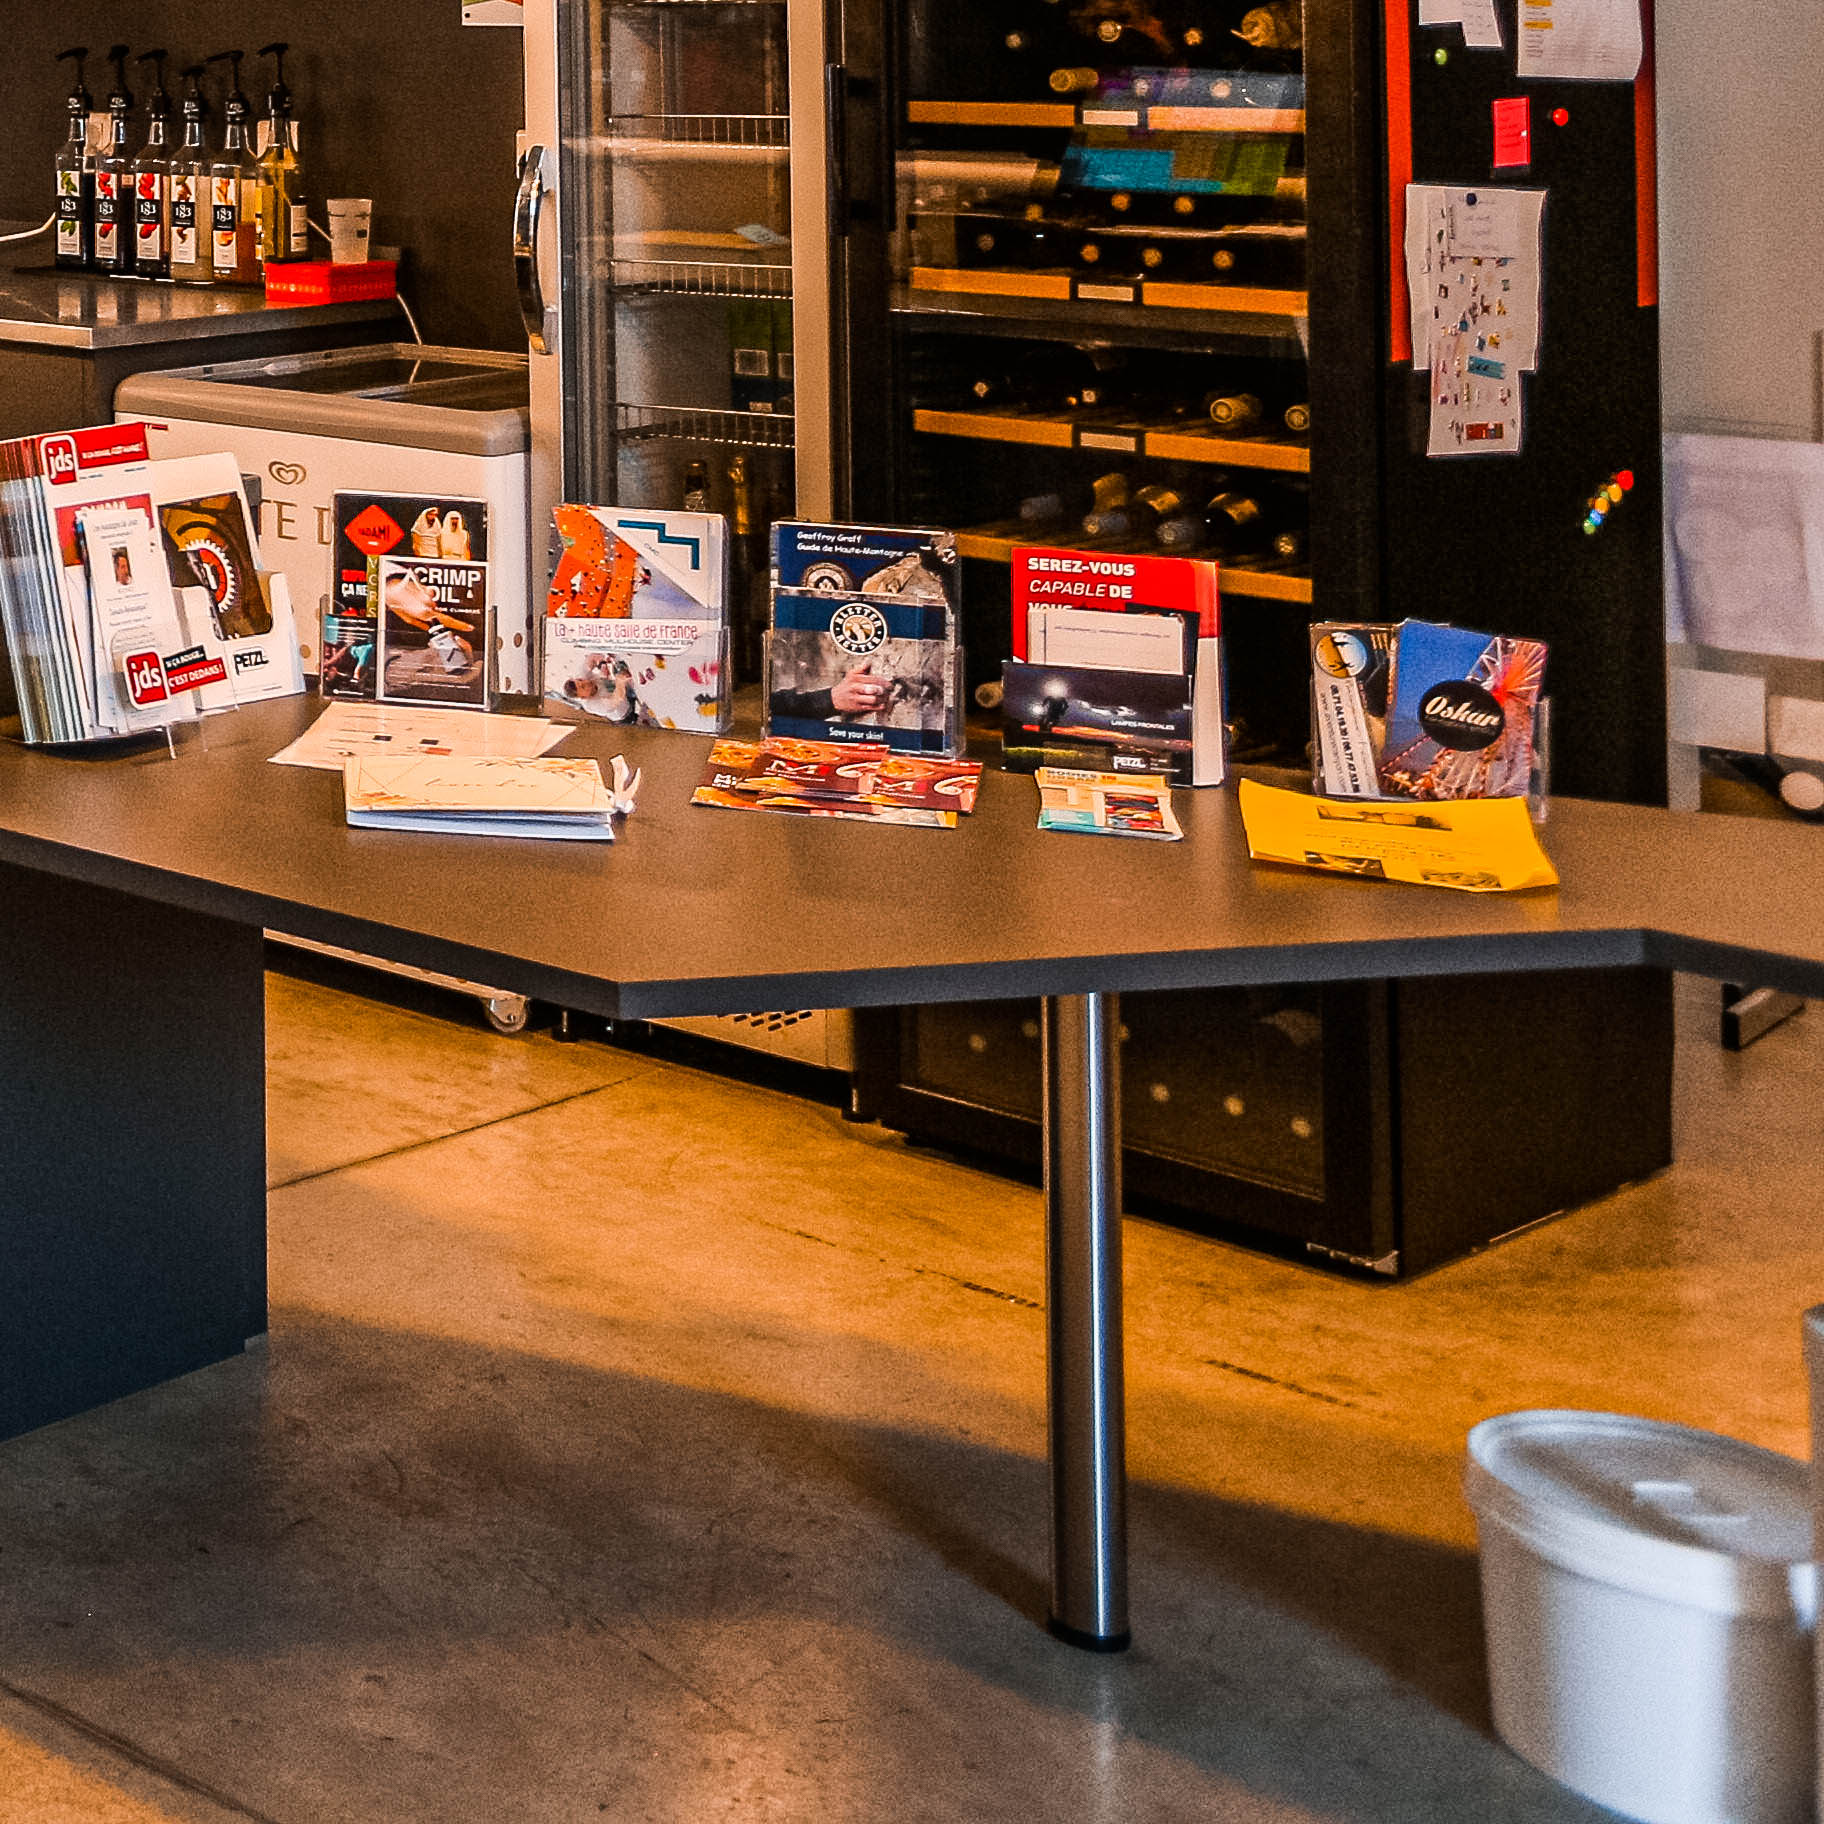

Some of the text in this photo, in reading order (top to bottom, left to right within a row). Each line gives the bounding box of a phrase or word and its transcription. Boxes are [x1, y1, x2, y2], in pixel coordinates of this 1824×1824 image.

[47, 447, 74, 480] jds
[1028, 557, 1135, 576] SEREZ-VOUS
[413, 567, 481, 587] CRIMP
[1029, 579, 1133, 599] CAPABLE DE
[234, 650, 269, 675] PETZL
[130, 660, 161, 698] jds
[829, 727, 847, 738] Save
[848, 730, 864, 740] your
